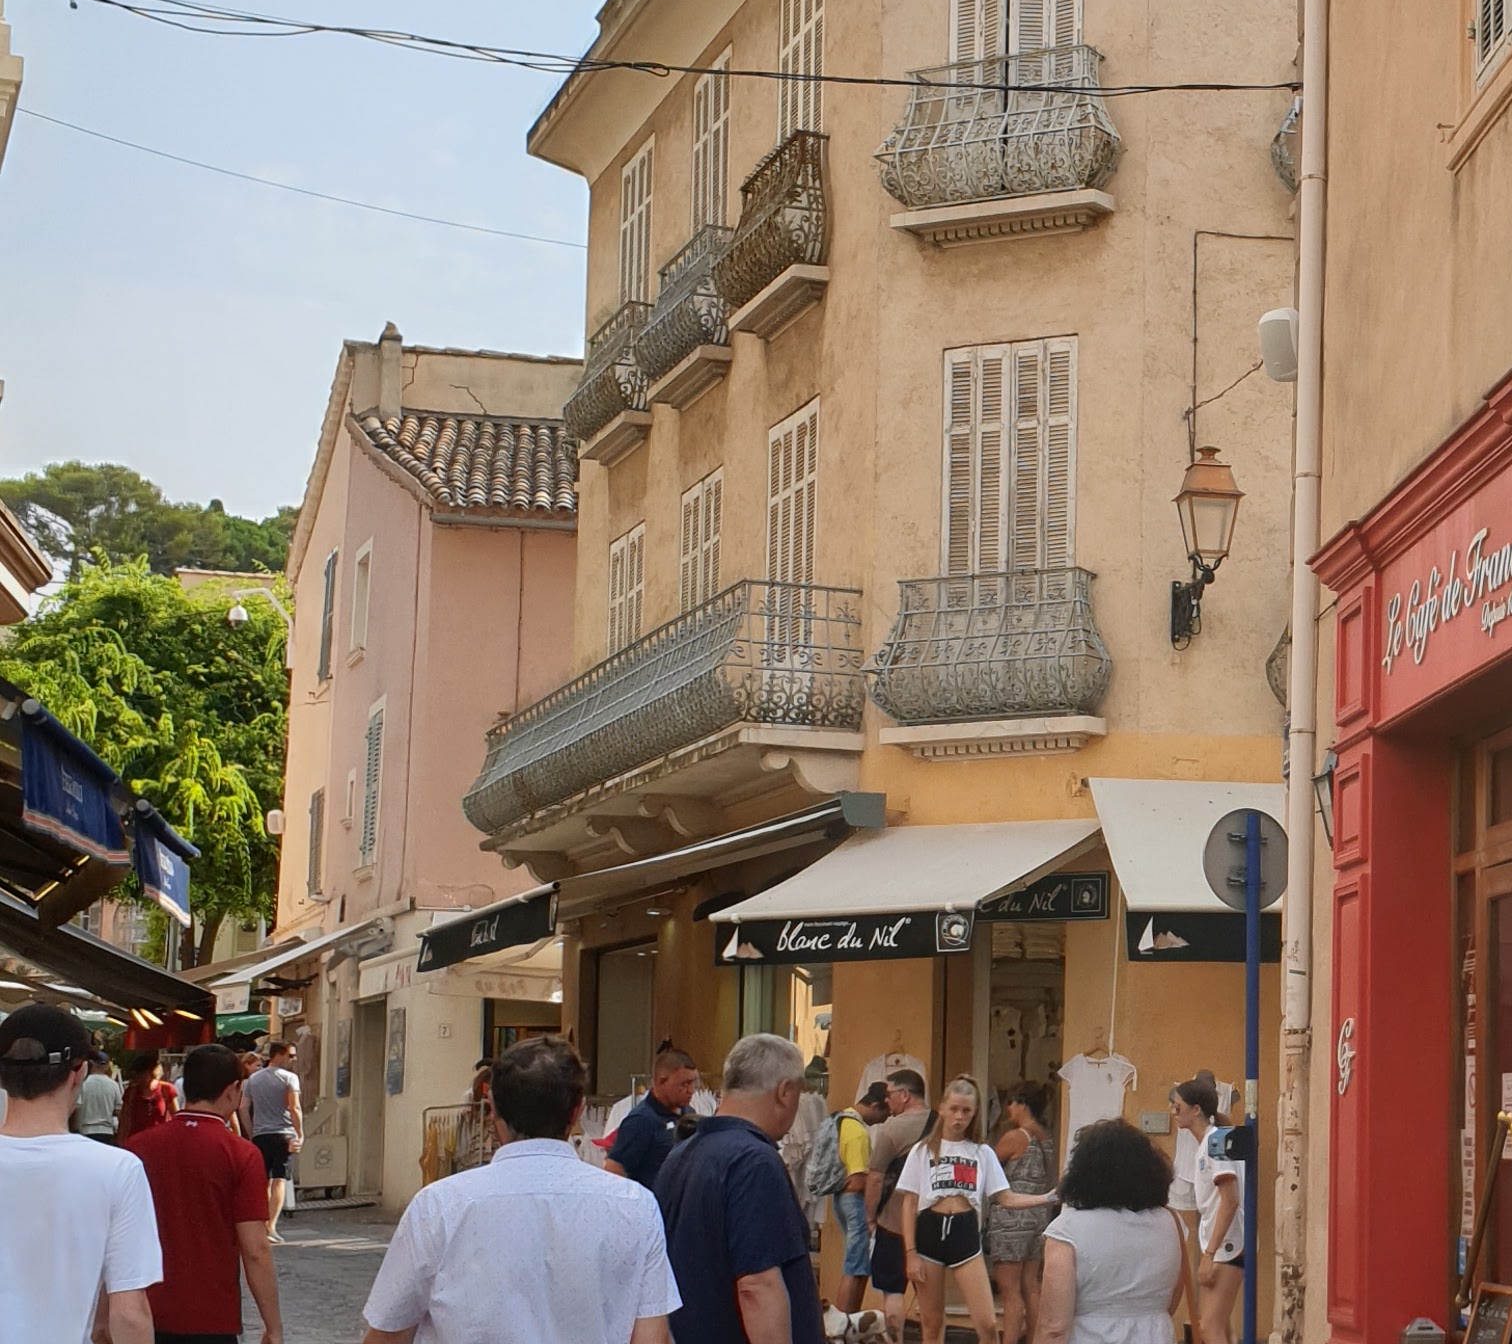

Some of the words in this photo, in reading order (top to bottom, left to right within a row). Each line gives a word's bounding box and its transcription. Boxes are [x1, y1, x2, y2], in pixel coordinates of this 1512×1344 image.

[1381, 592, 1403, 676] Le
[1406, 566, 1441, 665] Café
[1441, 550, 1463, 623] de
[998, 894, 1022, 913] du
[837, 922, 864, 949] du
[937, 1156, 975, 1167] OMMY
